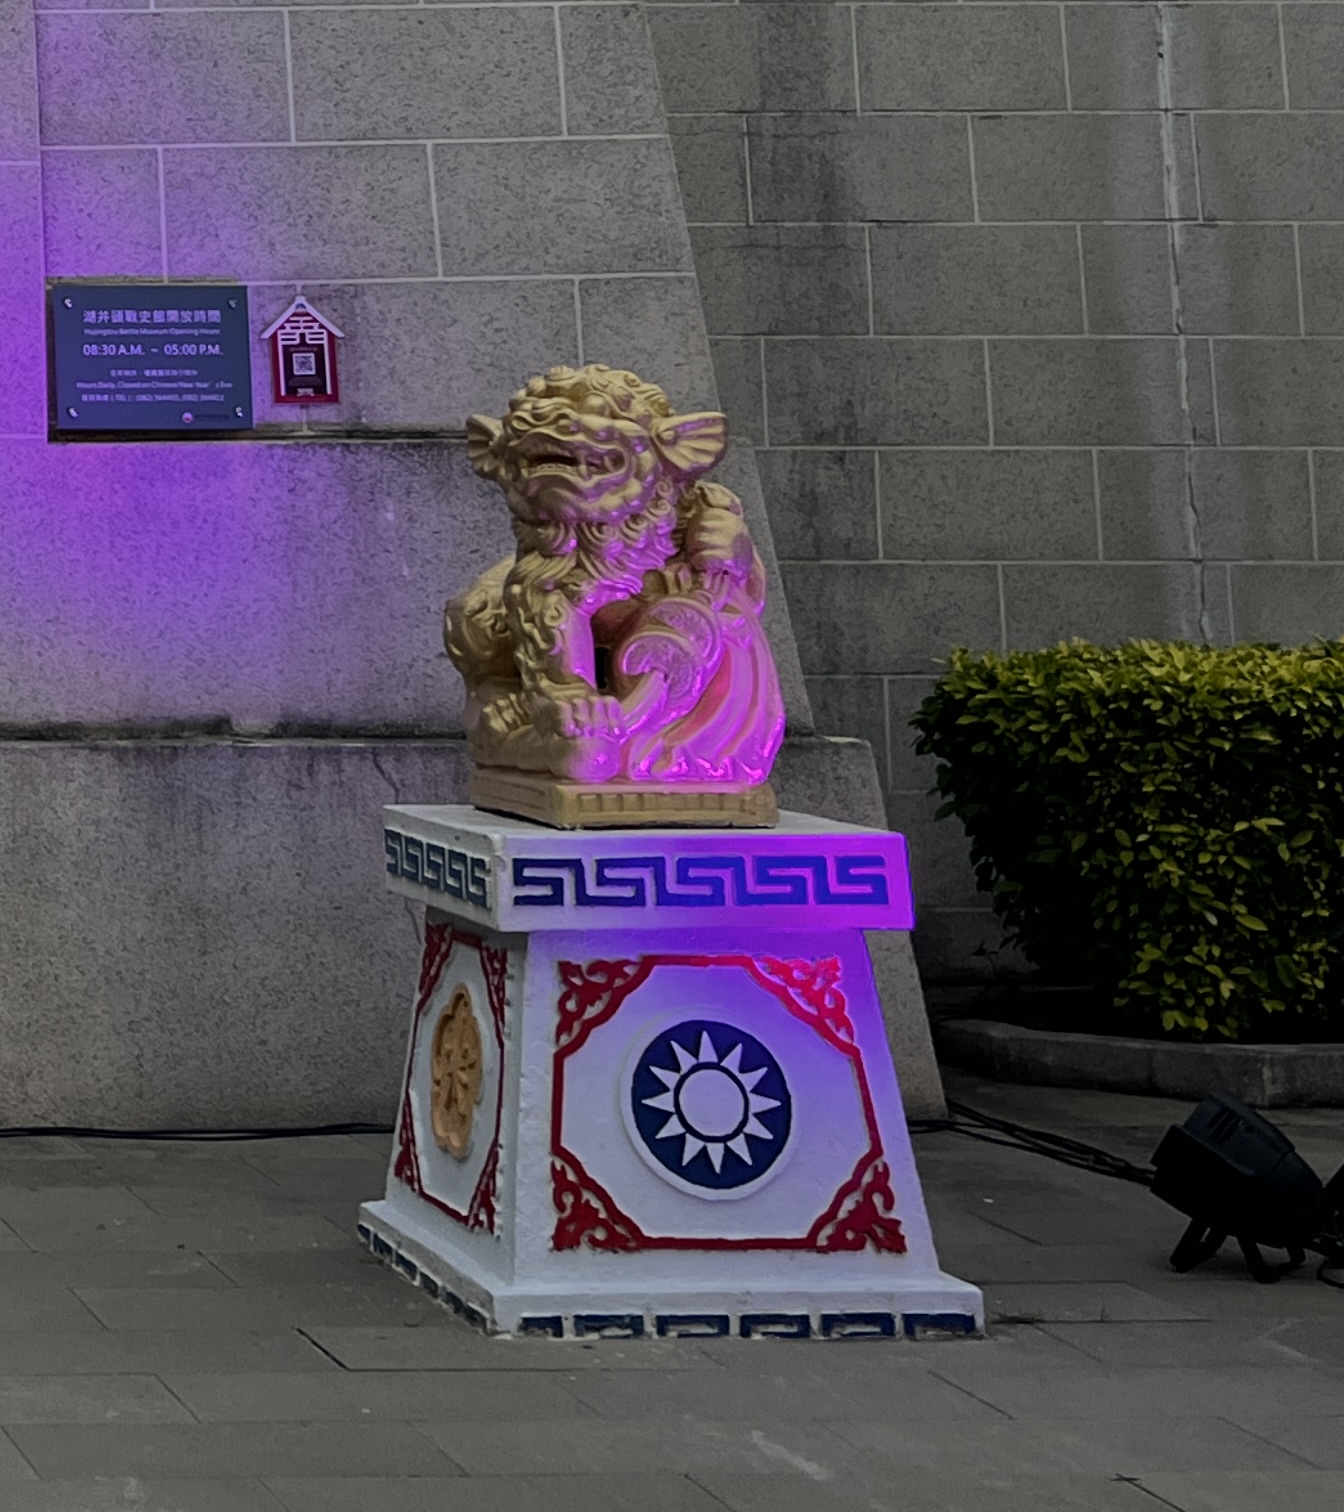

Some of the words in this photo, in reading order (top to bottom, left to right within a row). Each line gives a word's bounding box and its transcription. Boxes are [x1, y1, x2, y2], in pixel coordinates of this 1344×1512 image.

[82, 344, 116, 356] 08:30
[118, 344, 145, 356] A.M.
[163, 344, 198, 356] 05:00
[199, 344, 224, 356] P.M.
